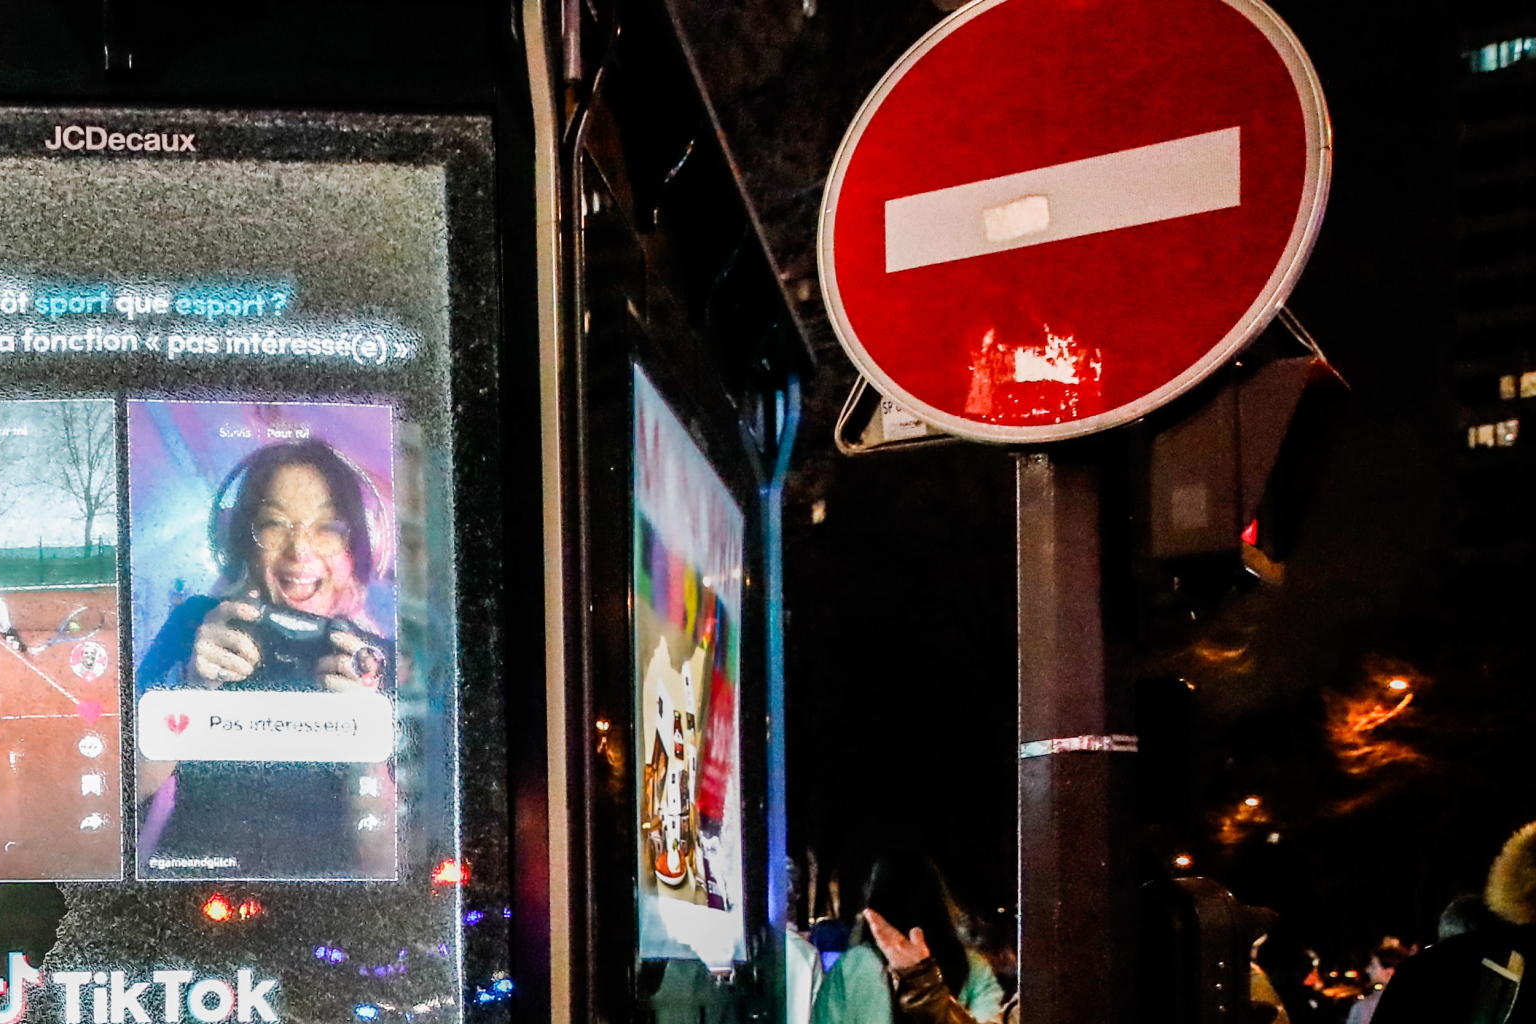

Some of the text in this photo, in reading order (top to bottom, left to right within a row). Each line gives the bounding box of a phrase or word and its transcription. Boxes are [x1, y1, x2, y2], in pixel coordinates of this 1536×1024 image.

[44, 125, 196, 151] JCDecaux
[34, 291, 109, 320] sport
[116, 295, 168, 320] que
[175, 293, 264, 321] esport
[22, 328, 138, 353] fonction
[167, 333, 219, 360] pas
[209, 715, 243, 731] Pas
[52, 968, 279, 1024] TikTok
